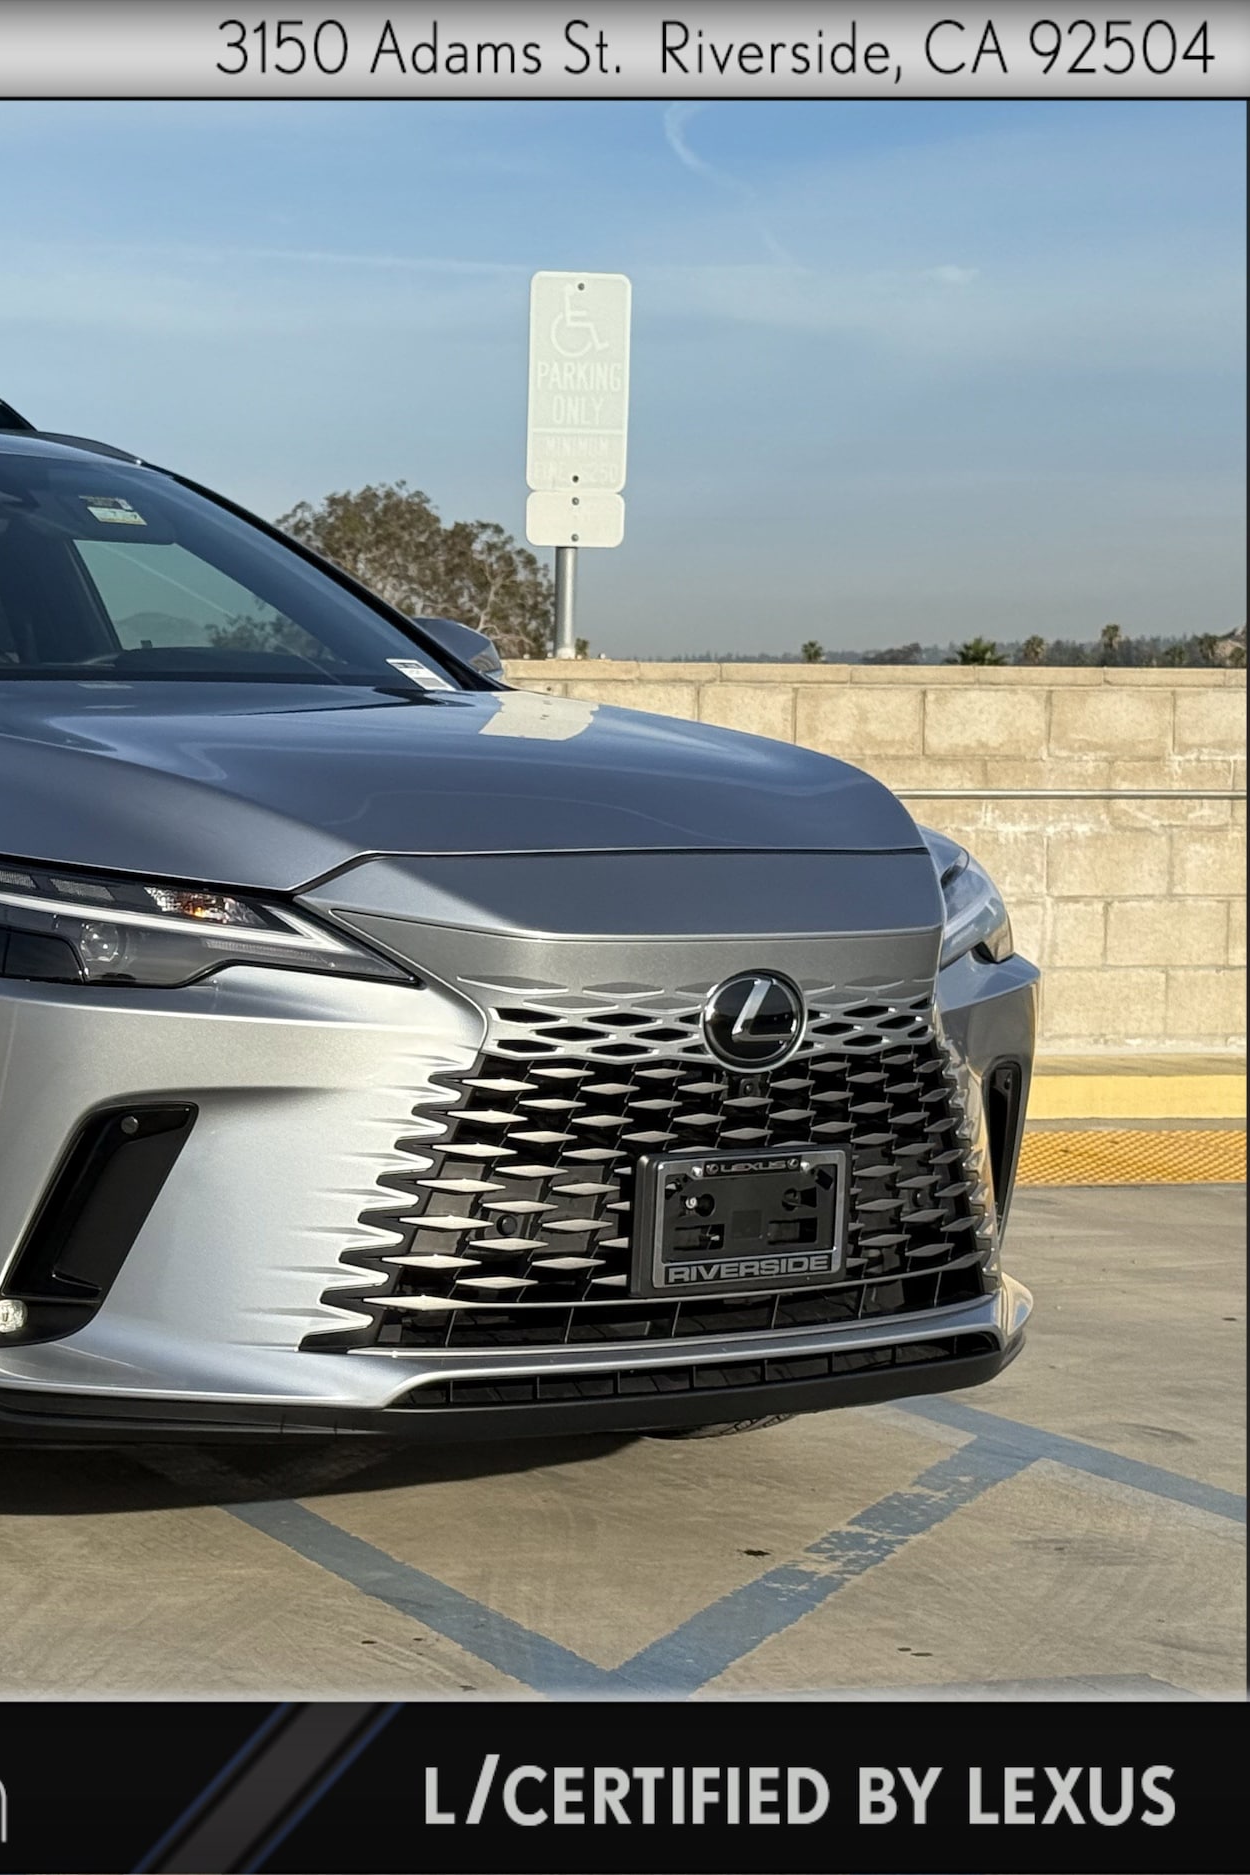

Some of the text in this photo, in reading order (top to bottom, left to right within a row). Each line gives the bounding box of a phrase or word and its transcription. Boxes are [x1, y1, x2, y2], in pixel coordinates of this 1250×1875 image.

[535, 361, 622, 392] PARKING
[552, 394, 605, 425] ONLY
[720, 1160, 787, 1173] LEXUS
[667, 1254, 830, 1284] RIVERSIDE
